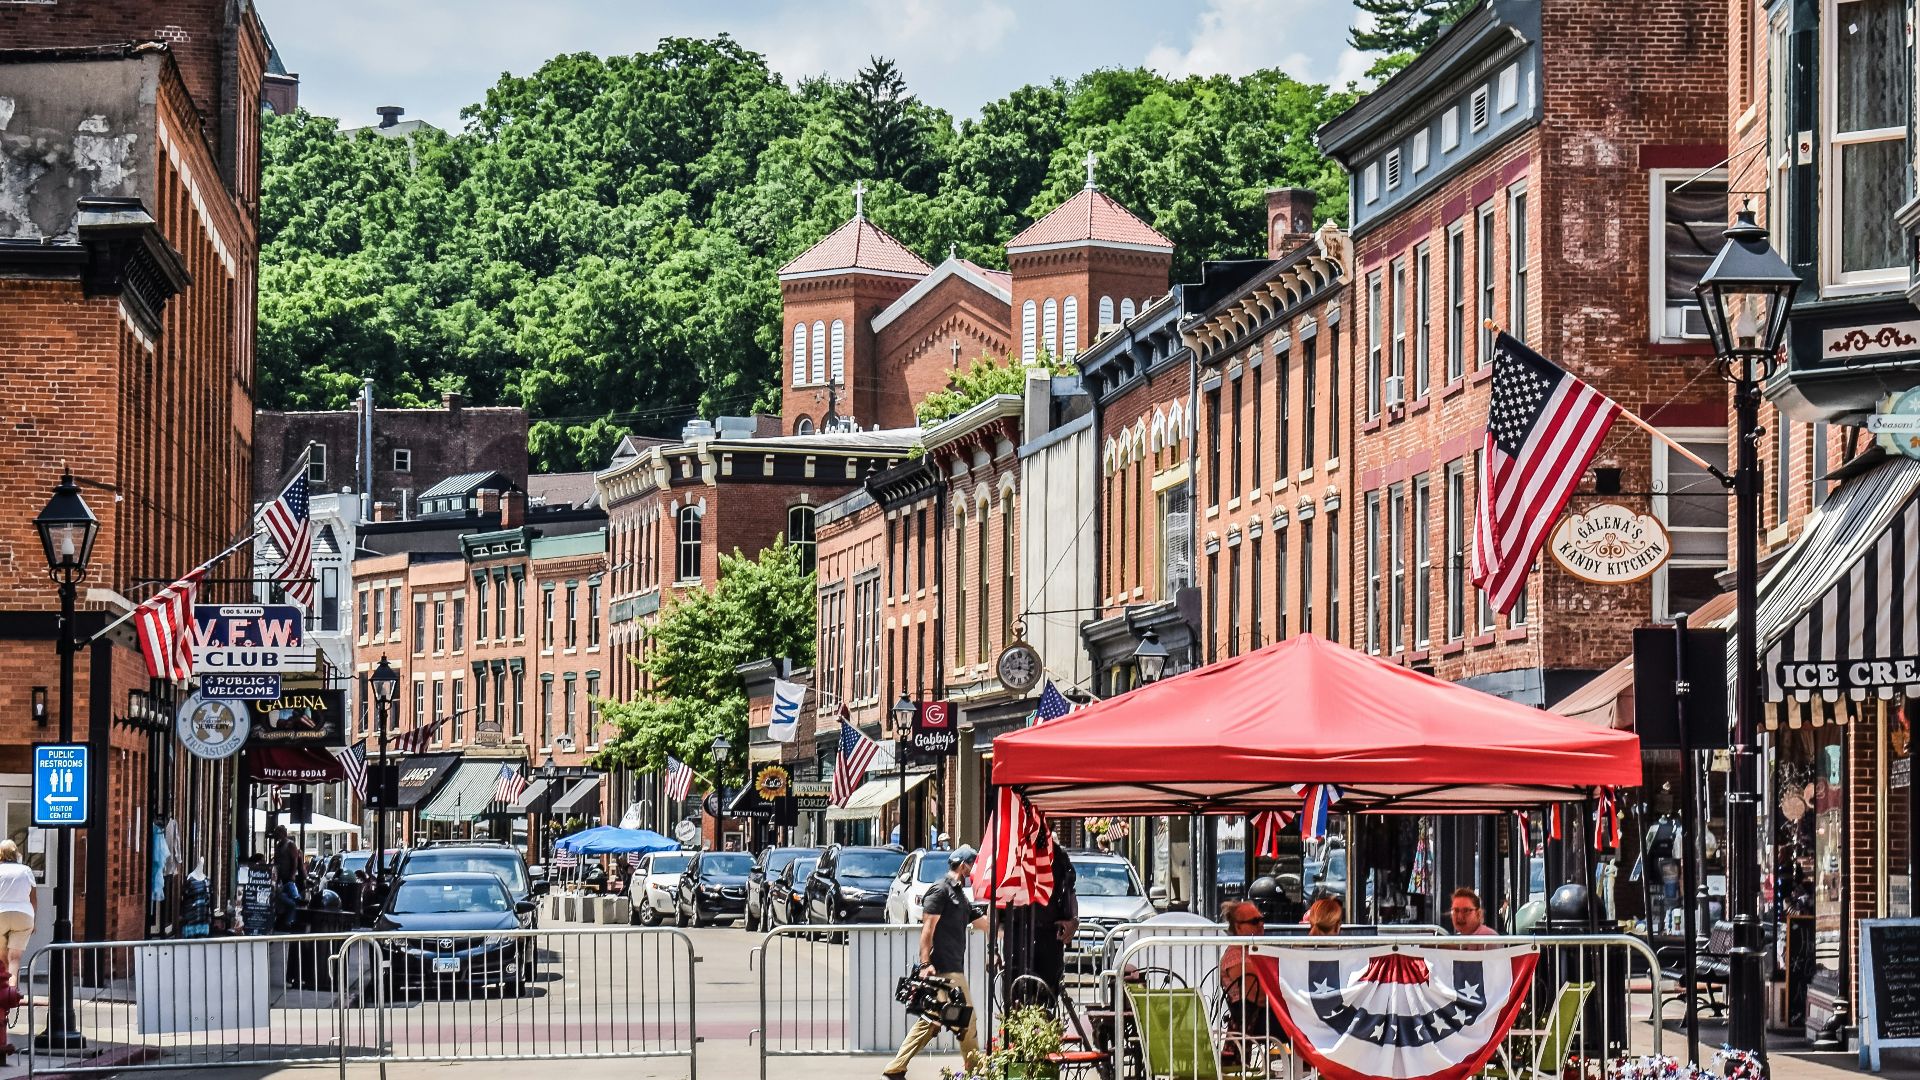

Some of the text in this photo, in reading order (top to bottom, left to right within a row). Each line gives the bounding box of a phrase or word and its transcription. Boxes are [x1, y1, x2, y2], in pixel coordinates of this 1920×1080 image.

[1873, 417, 1913, 429] Seasons
[1577, 516, 1643, 539] GALENA'S
[1559, 541, 1663, 575] KANDY KITCHEN
[205, 651, 279, 667] CLUB
[216, 676, 265, 685] PUBLIC
[1783, 659, 1920, 687] ICE CRE
[207, 686, 274, 695] WELCOME
[256, 695, 328, 713] GALENA
[925, 704, 945, 724] G
[185, 733, 241, 756] TREASURES
[914, 731, 956, 751] Gabby's
[48, 750, 75, 759] PUBLIC
[39, 759, 83, 768] RESTROOMS
[263, 768, 327, 777] VINTAGE SODAS
